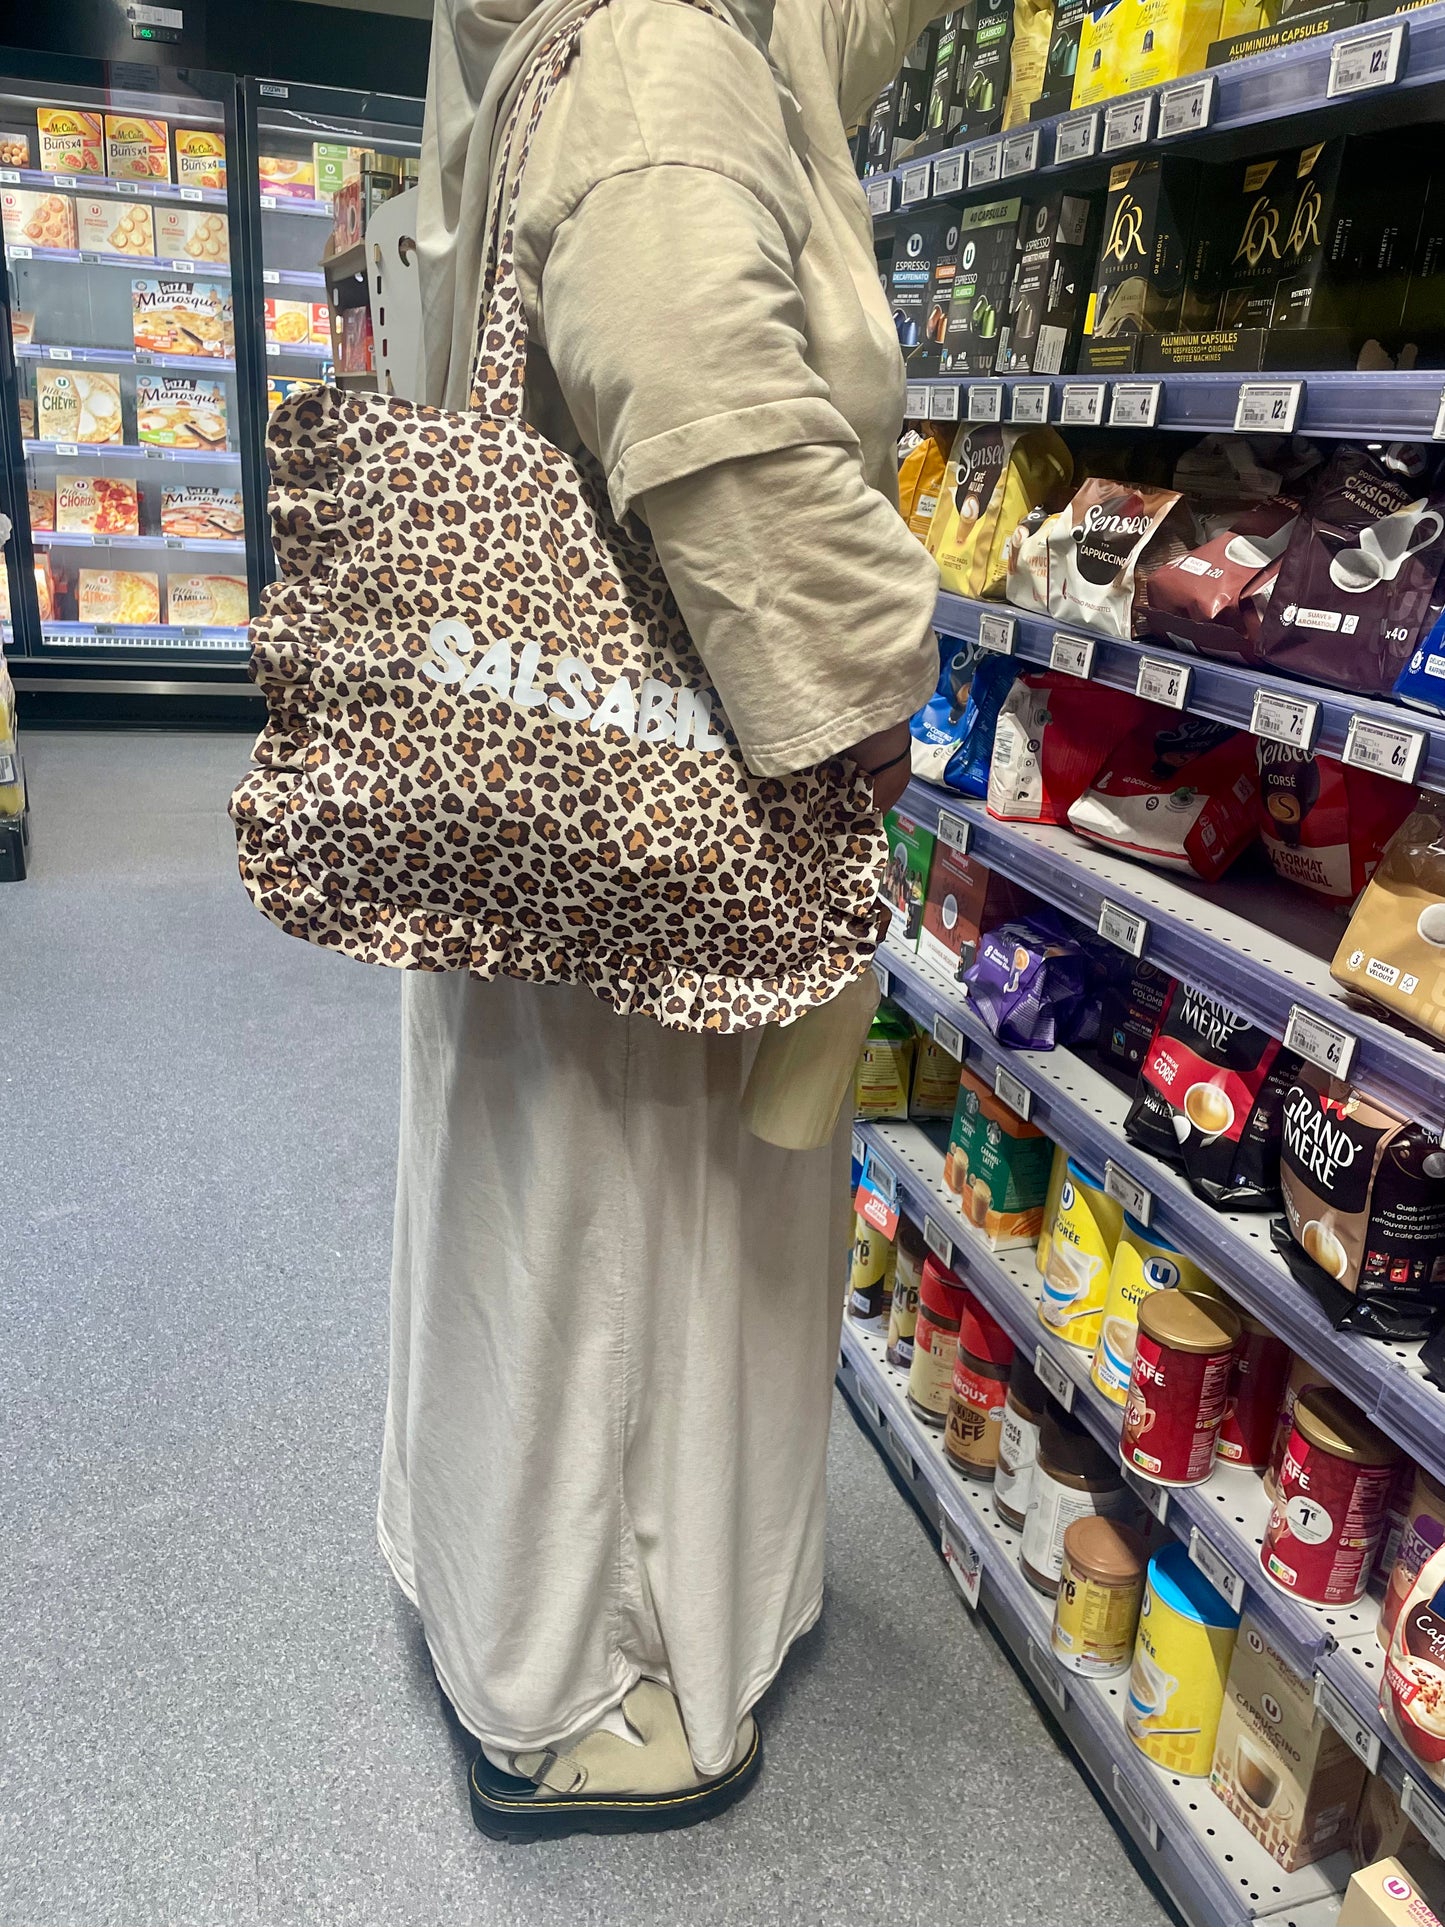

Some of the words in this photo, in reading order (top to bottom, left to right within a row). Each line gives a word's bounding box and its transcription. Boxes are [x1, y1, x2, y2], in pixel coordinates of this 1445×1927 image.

[1229, 33, 1279, 56] ALUMINIUM
[1281, 20, 1329, 42] CAPSULES
[50, 121, 79, 133] McCain
[117, 129, 145, 141] McCain
[188, 145, 214, 154] McCain
[979, 205, 1008, 221] CAPSULES
[1331, 219, 1344, 260] RISTRETTO
[895, 261, 930, 271] ESPRESSO
[137, 292, 217, 309] Manosque
[1161, 335, 1199, 346] ALUMINIUM
[1200, 332, 1238, 345] CAPSULES
[1161, 347, 1172, 355] FOR
[1208, 345, 1235, 353] ORIGINAL
[1193, 354, 1221, 362] MACHINES
[141, 388, 219, 405] Manosque
[1382, 480, 1409, 500] SOUPLES
[60, 495, 96, 508] CHORIZO
[165, 493, 241, 506] Manosque
[1070, 504, 1153, 543] Senseo
[1206, 568, 1223, 578] x20
[1297, 618, 1336, 629] AROMATIQUE
[1307, 611, 1327, 621] SUAVE
[1384, 628, 1408, 641] x40
[1391, 745, 1401, 765] 6
[1267, 773, 1296, 788] CORSÉ
[1280, 851, 1323, 874] FORMAT
[1283, 863, 1333, 888] FAMILIAL
[1372, 960, 1389, 973] DOUX
[1132, 988, 1163, 1007] COLOMB
[1326, 1042, 1336, 1060] 6
[980, 1145, 999, 1165] CARAMEL
[982, 1156, 995, 1170] LATTE
[1382, 1209, 1396, 1219] vos
[1371, 1215, 1408, 1230] retrouvez
[1382, 1228, 1394, 1237] du
[1150, 1263, 1171, 1284] U
[1235, 1692, 1301, 1763] CAPPUCCINO
[1252, 1720, 1281, 1750] NATURE
[1387, 1880, 1406, 1895] U
